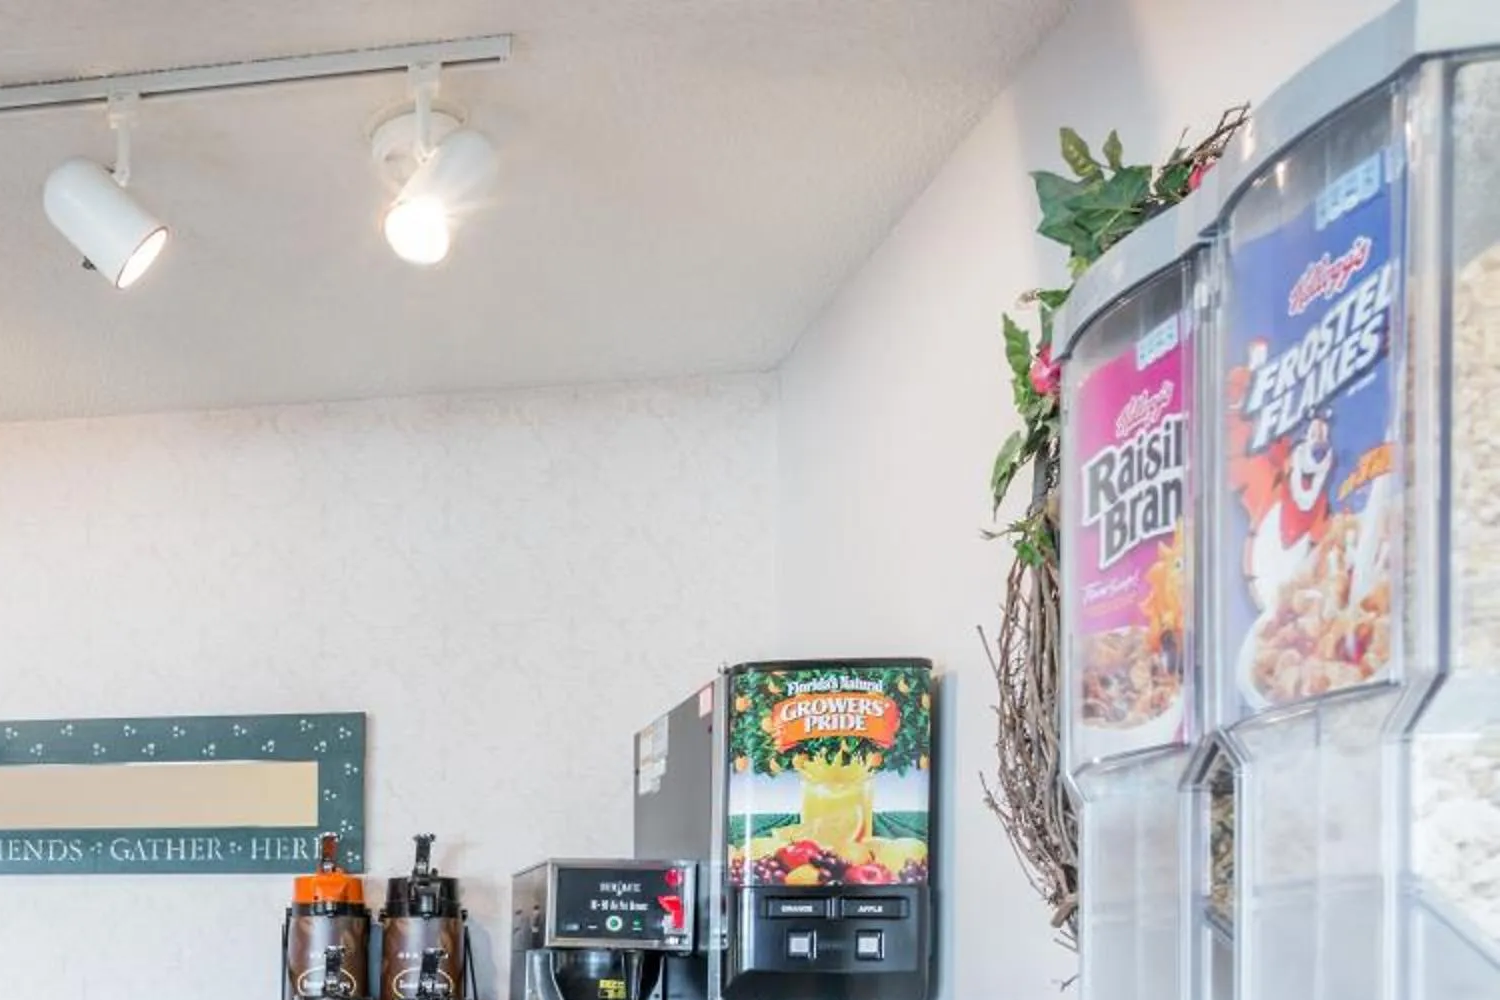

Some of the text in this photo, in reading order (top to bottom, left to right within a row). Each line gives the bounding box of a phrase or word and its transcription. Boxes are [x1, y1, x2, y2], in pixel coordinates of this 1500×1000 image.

[1252, 311, 1384, 450] FLAKES
[1100, 474, 1183, 568] Bran
[804, 714, 866, 734] PRIDE
[109, 836, 223, 861] GATHER
